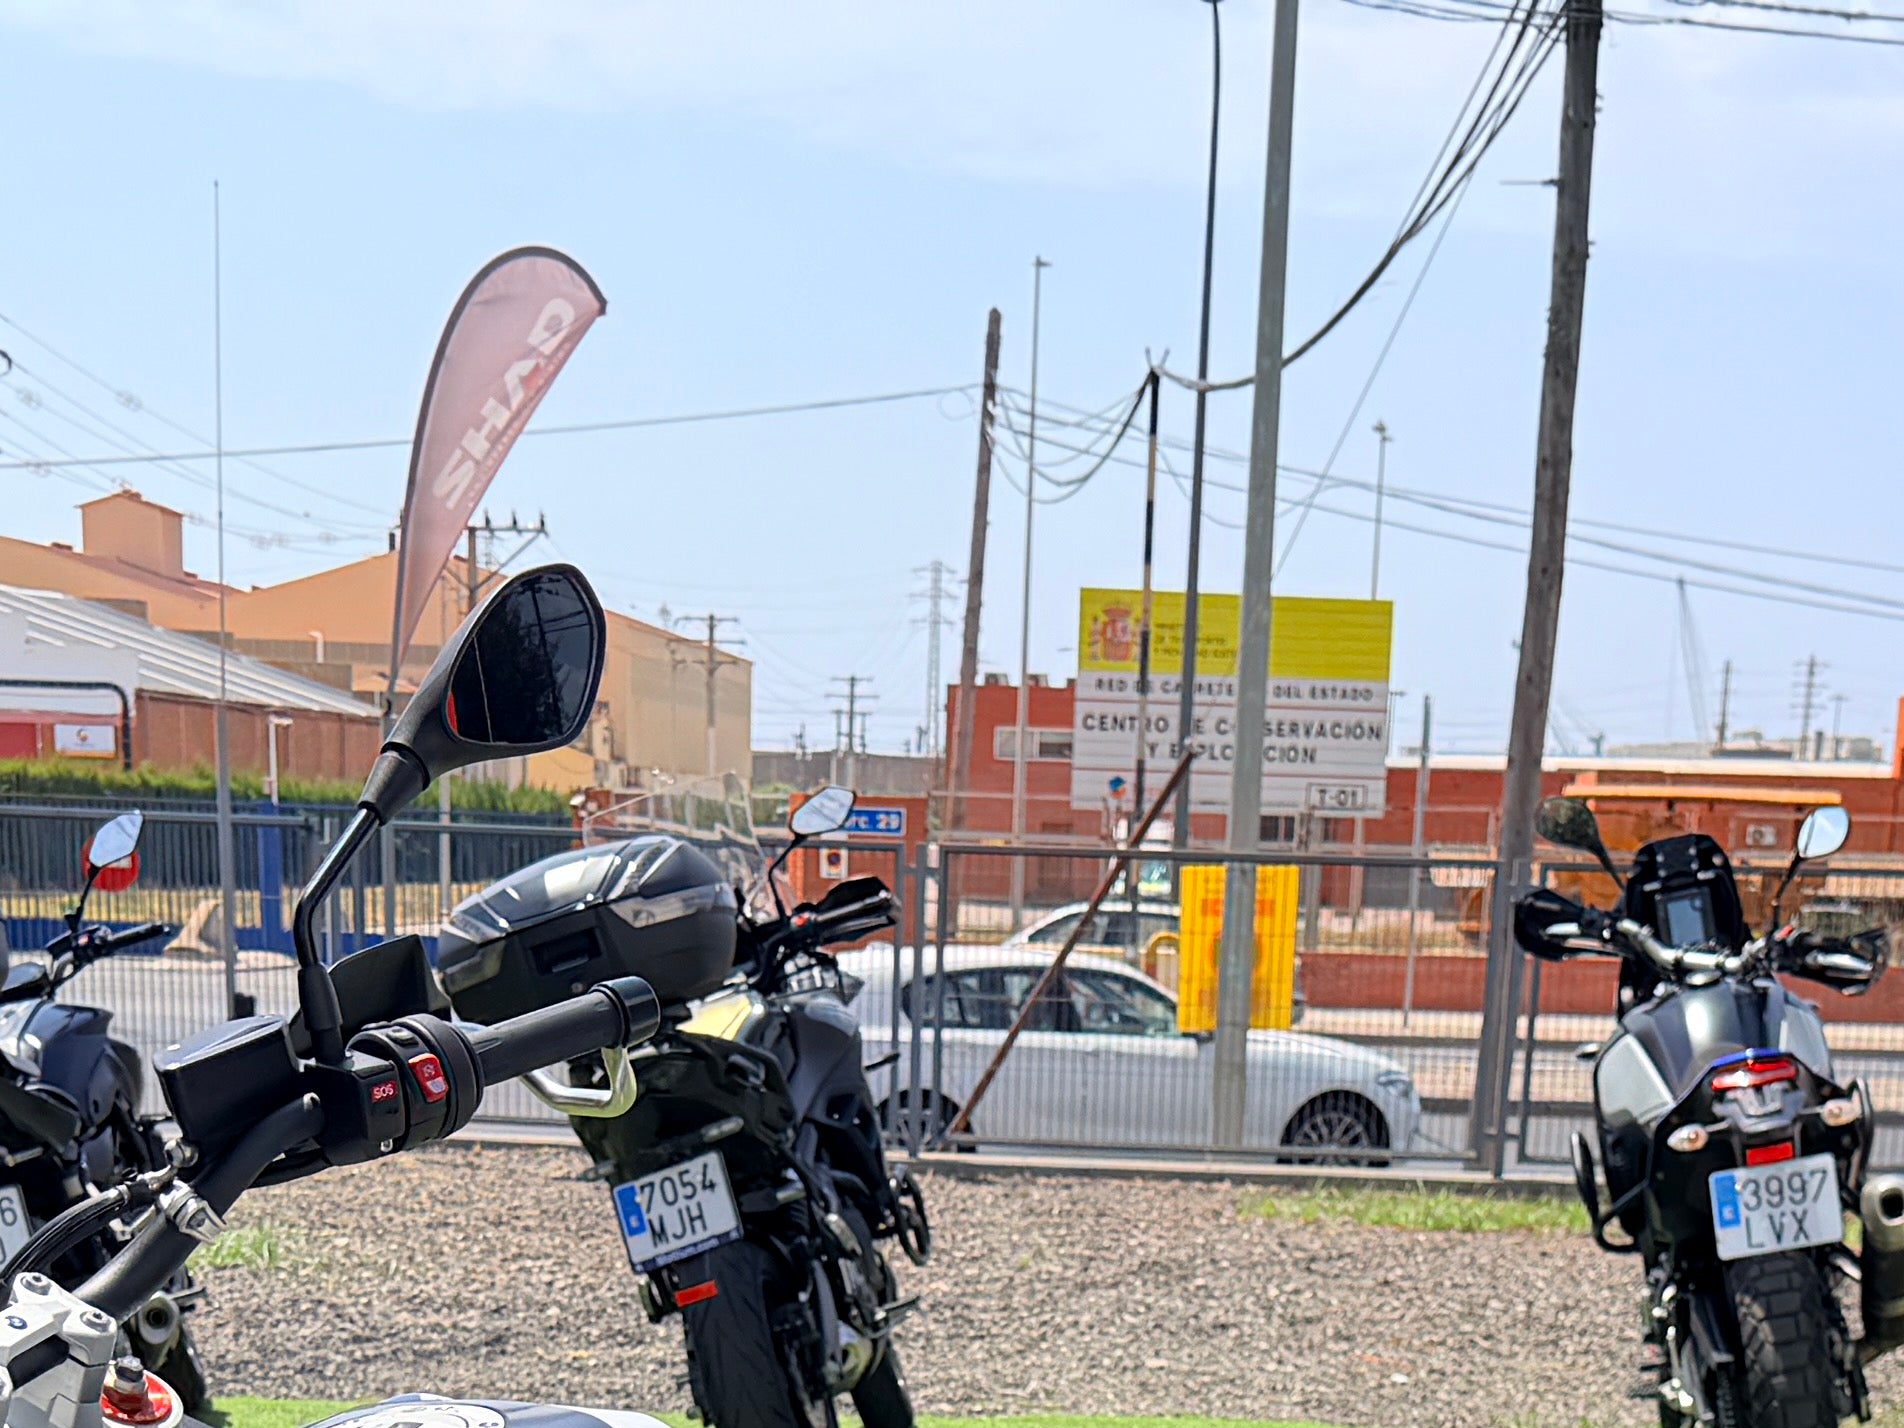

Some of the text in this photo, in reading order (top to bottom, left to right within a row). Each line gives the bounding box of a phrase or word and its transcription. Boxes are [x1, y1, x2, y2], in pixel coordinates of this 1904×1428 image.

[1214, 717, 1383, 742] CSERVACIÓN
[1146, 743, 1159, 759] Y
[373, 1083, 394, 1099] SOS
[640, 1162, 717, 1214] 7054
[1741, 1168, 1828, 1211] 3997
[647, 1201, 707, 1248] MJH
[1745, 1208, 1810, 1248] LVX
